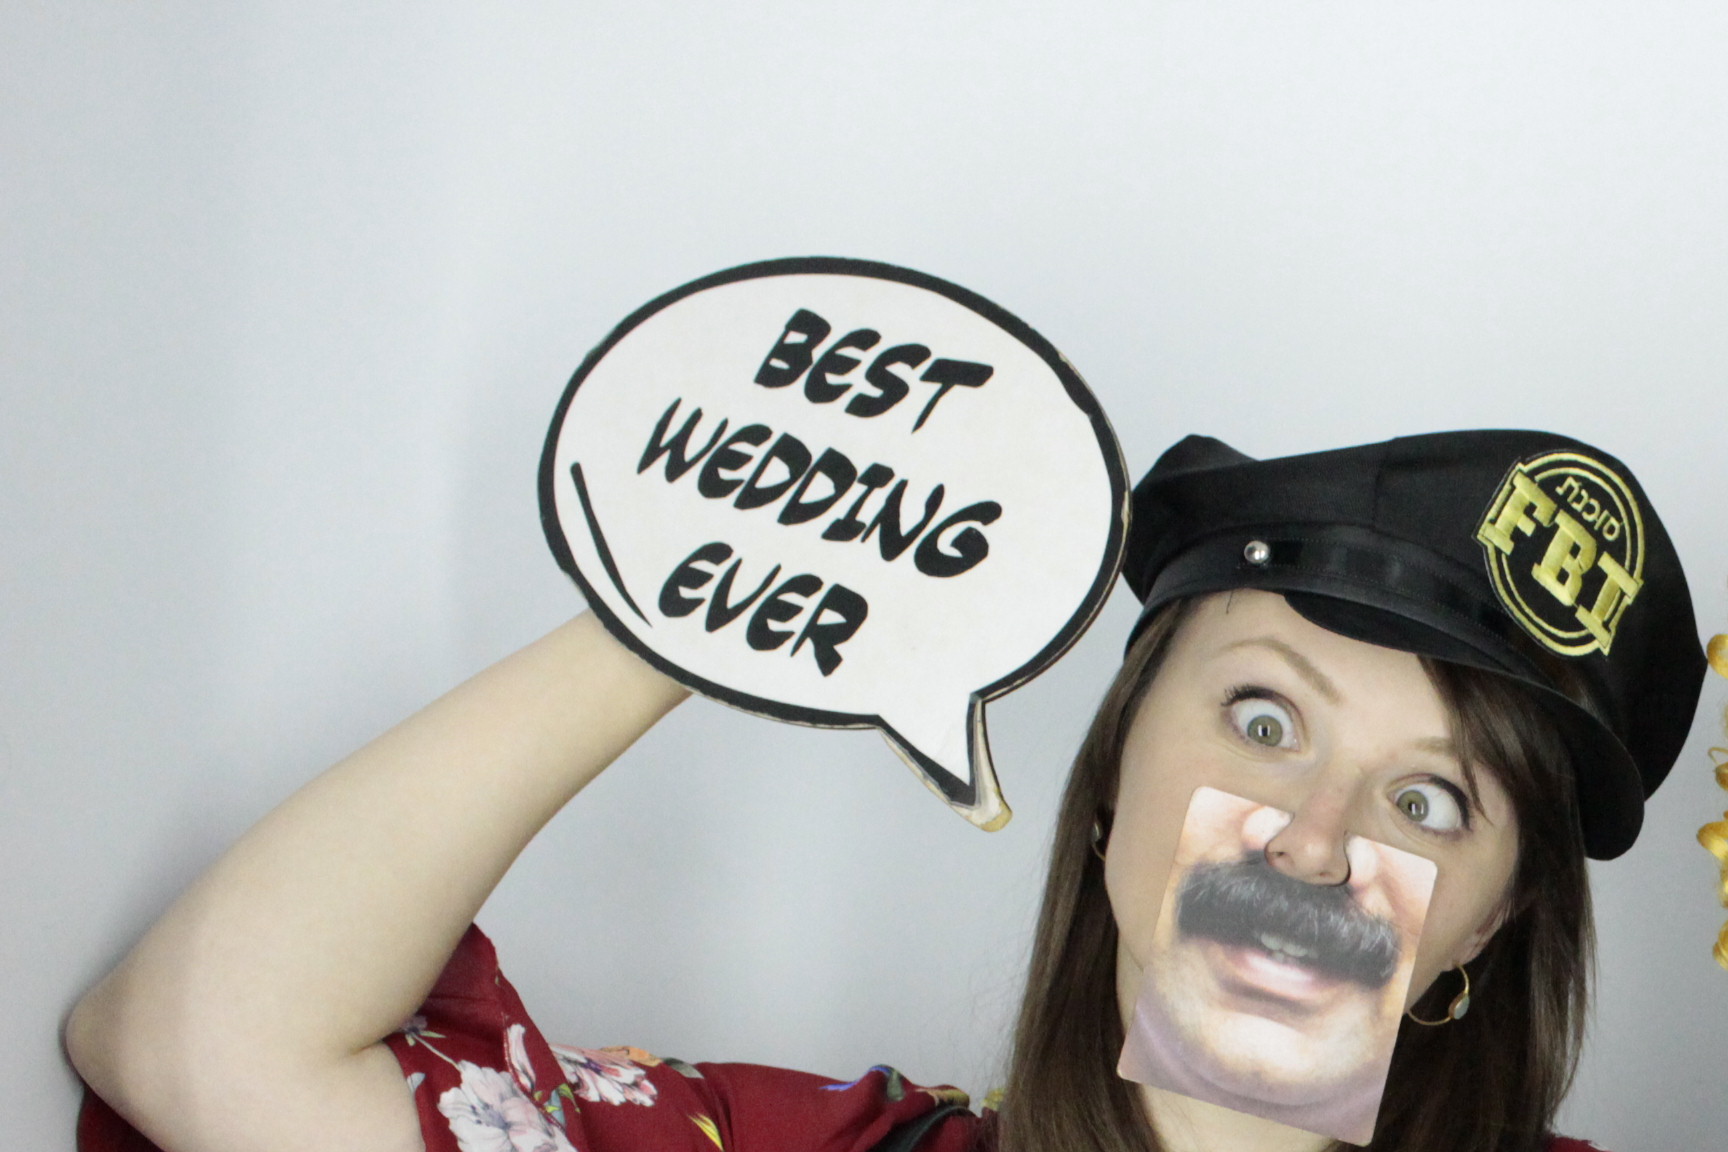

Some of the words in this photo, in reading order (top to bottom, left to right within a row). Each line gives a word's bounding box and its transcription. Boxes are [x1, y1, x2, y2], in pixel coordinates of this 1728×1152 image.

[754, 308, 994, 432] BEST
[636, 397, 1003, 578] WEDDING
[1555, 475, 1622, 542] סוכנת
[657, 541, 869, 678] EVER
[1477, 464, 1643, 655] FBI
